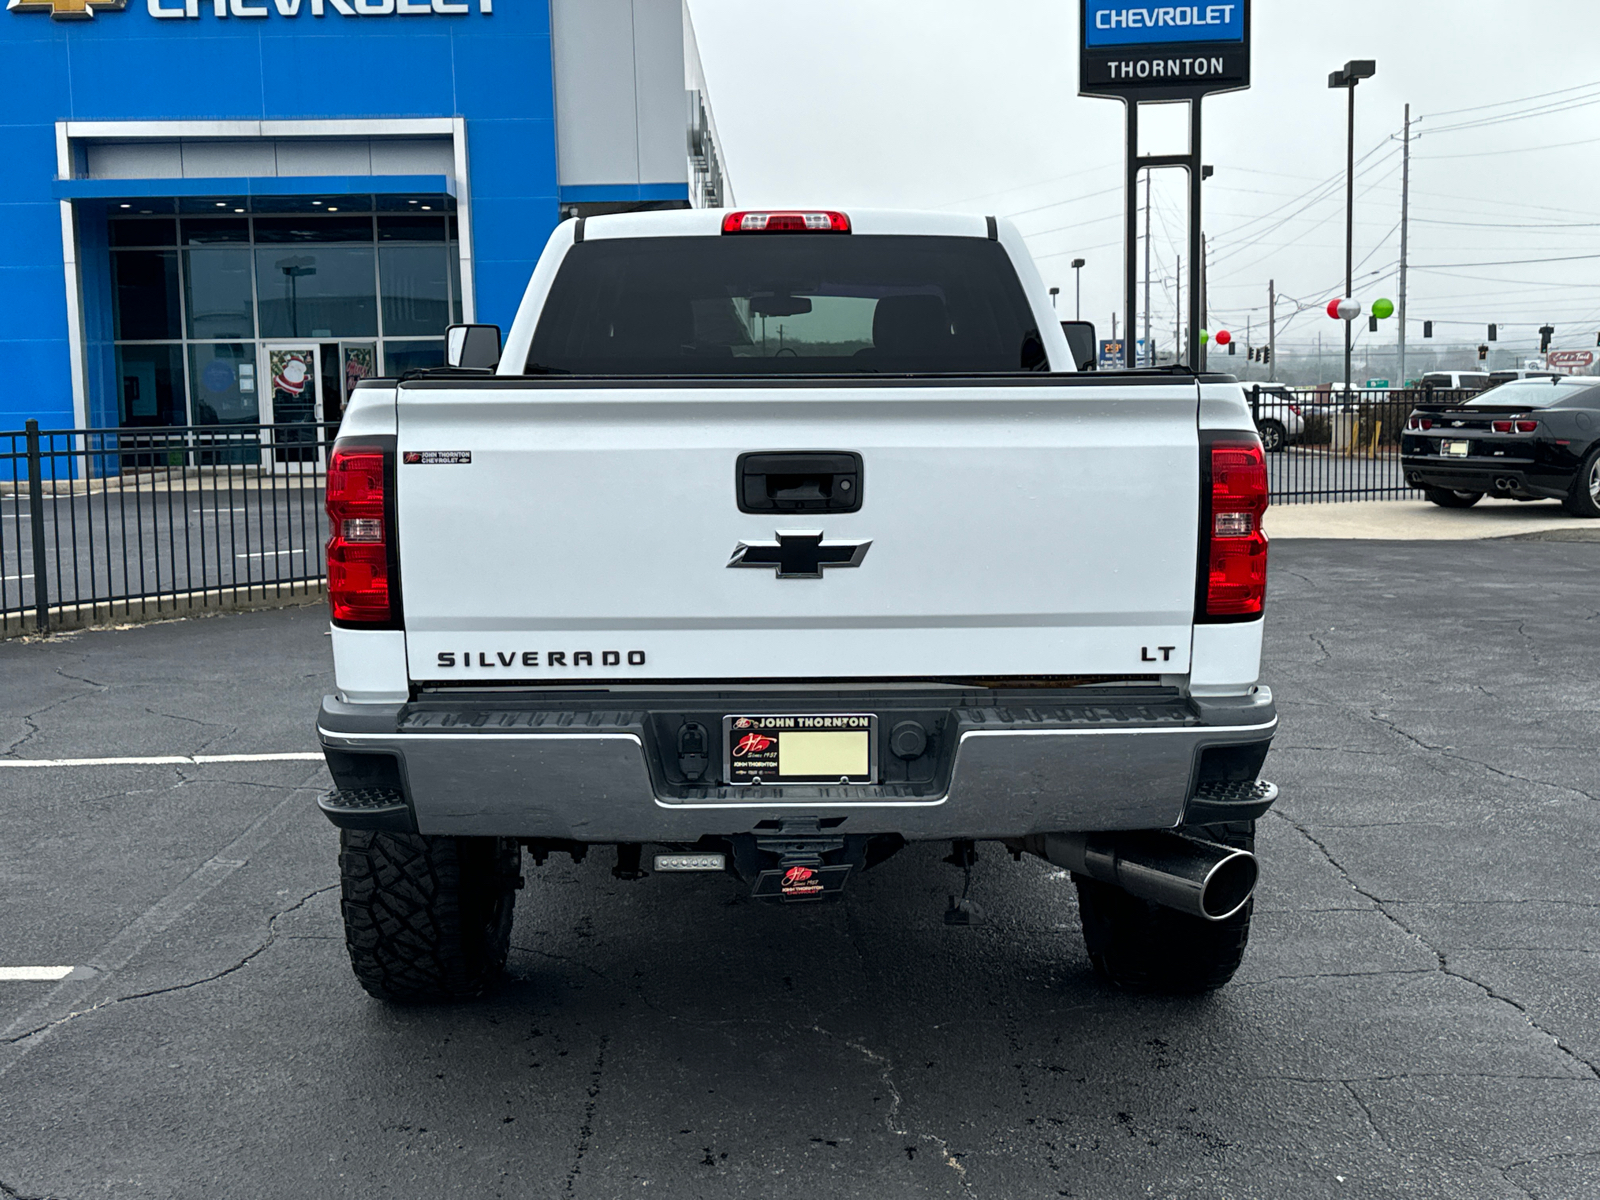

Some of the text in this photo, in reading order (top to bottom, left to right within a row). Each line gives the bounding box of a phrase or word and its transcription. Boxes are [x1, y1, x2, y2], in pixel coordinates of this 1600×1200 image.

[1095, 5, 1235, 29] CHEVROLET
[1107, 57, 1223, 79] THORNTON
[437, 650, 646, 668] SILVERADO
[1141, 646, 1176, 662] LT
[759, 717, 795, 728] JOHN
[797, 716, 869, 728] THORNTON
